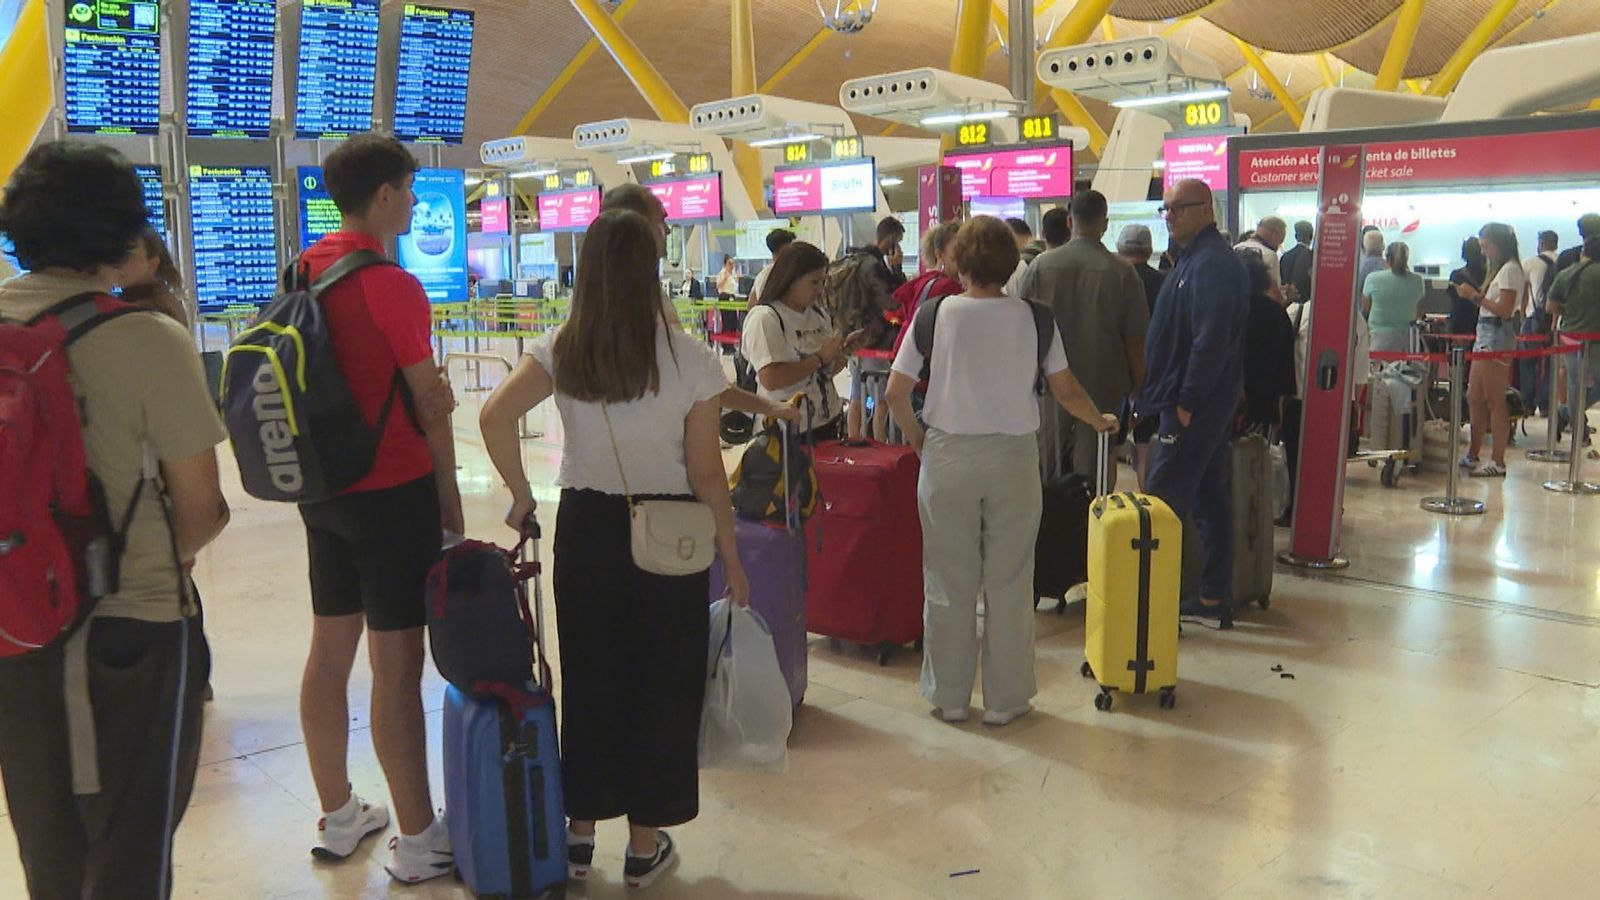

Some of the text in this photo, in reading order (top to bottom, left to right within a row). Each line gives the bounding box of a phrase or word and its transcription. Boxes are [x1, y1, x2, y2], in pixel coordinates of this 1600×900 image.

[1185, 102, 1221, 126] 810
[960, 116, 1052, 145] 812 811
[786, 143, 807, 162] 814
[1250, 155, 1297, 168] Atención
[1299, 153, 1309, 165] al
[1366, 147, 1457, 161] enta de billetes
[1251, 171, 1319, 183] Customer serv
[1365, 165, 1414, 178] cket sale
[252, 364, 304, 493] arena
